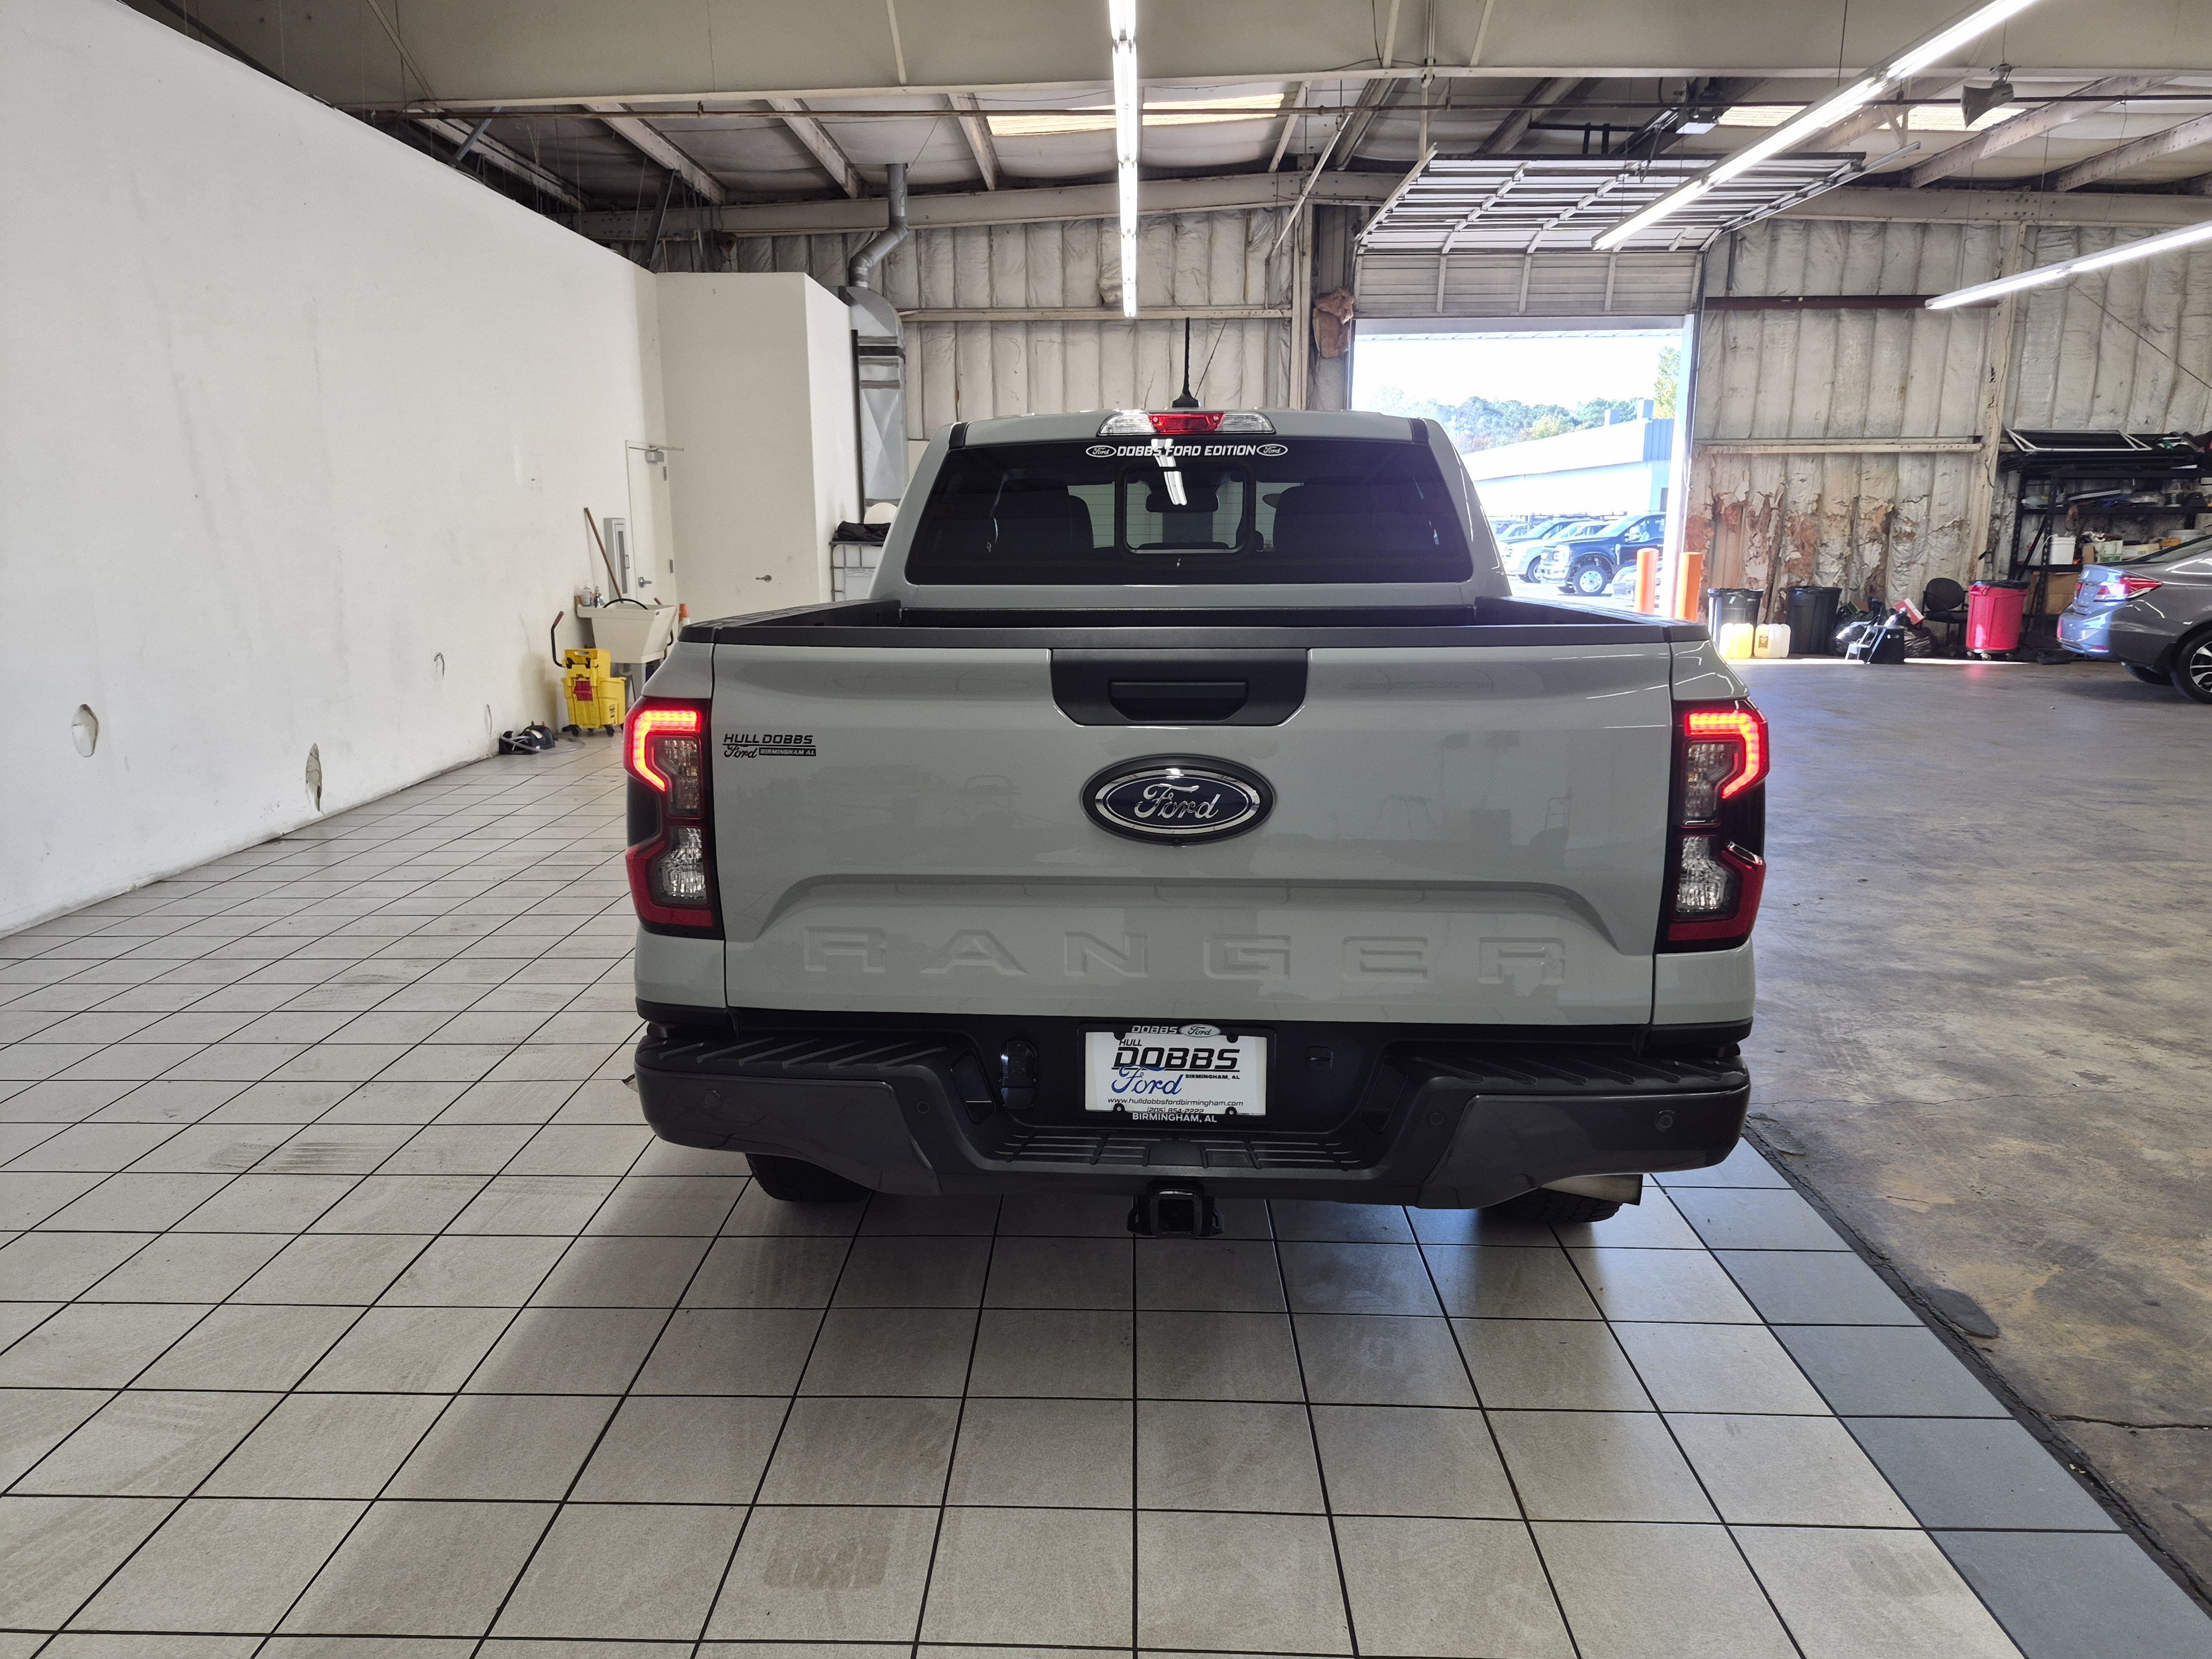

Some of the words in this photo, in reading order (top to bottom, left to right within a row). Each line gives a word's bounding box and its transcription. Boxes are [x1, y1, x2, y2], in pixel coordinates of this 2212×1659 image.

[1092, 447, 1110, 456] Ford
[1117, 446, 1161, 456] DOBBS
[1166, 446, 1201, 456] FORD
[1204, 445, 1256, 456] EDITION
[1263, 446, 1281, 454] Ford
[724, 734, 759, 743] HULL
[762, 734, 813, 744] DOBBS
[724, 744, 758, 758] Ford
[1134, 783, 1221, 819] Ford
[804, 926, 1567, 985] RANGER
[1131, 1025, 1178, 1034] DOBBS
[1187, 1025, 1213, 1036] Ford
[1114, 1047, 1240, 1069] DOBBS
[1112, 1065, 1183, 1095] Ford
[1108, 1098, 1243, 1107] www.hulldobbsfordbirmingham.com
[1133, 1113, 1202, 1123] BIRMINGHAM,
[1204, 1114, 1217, 1123] AL
